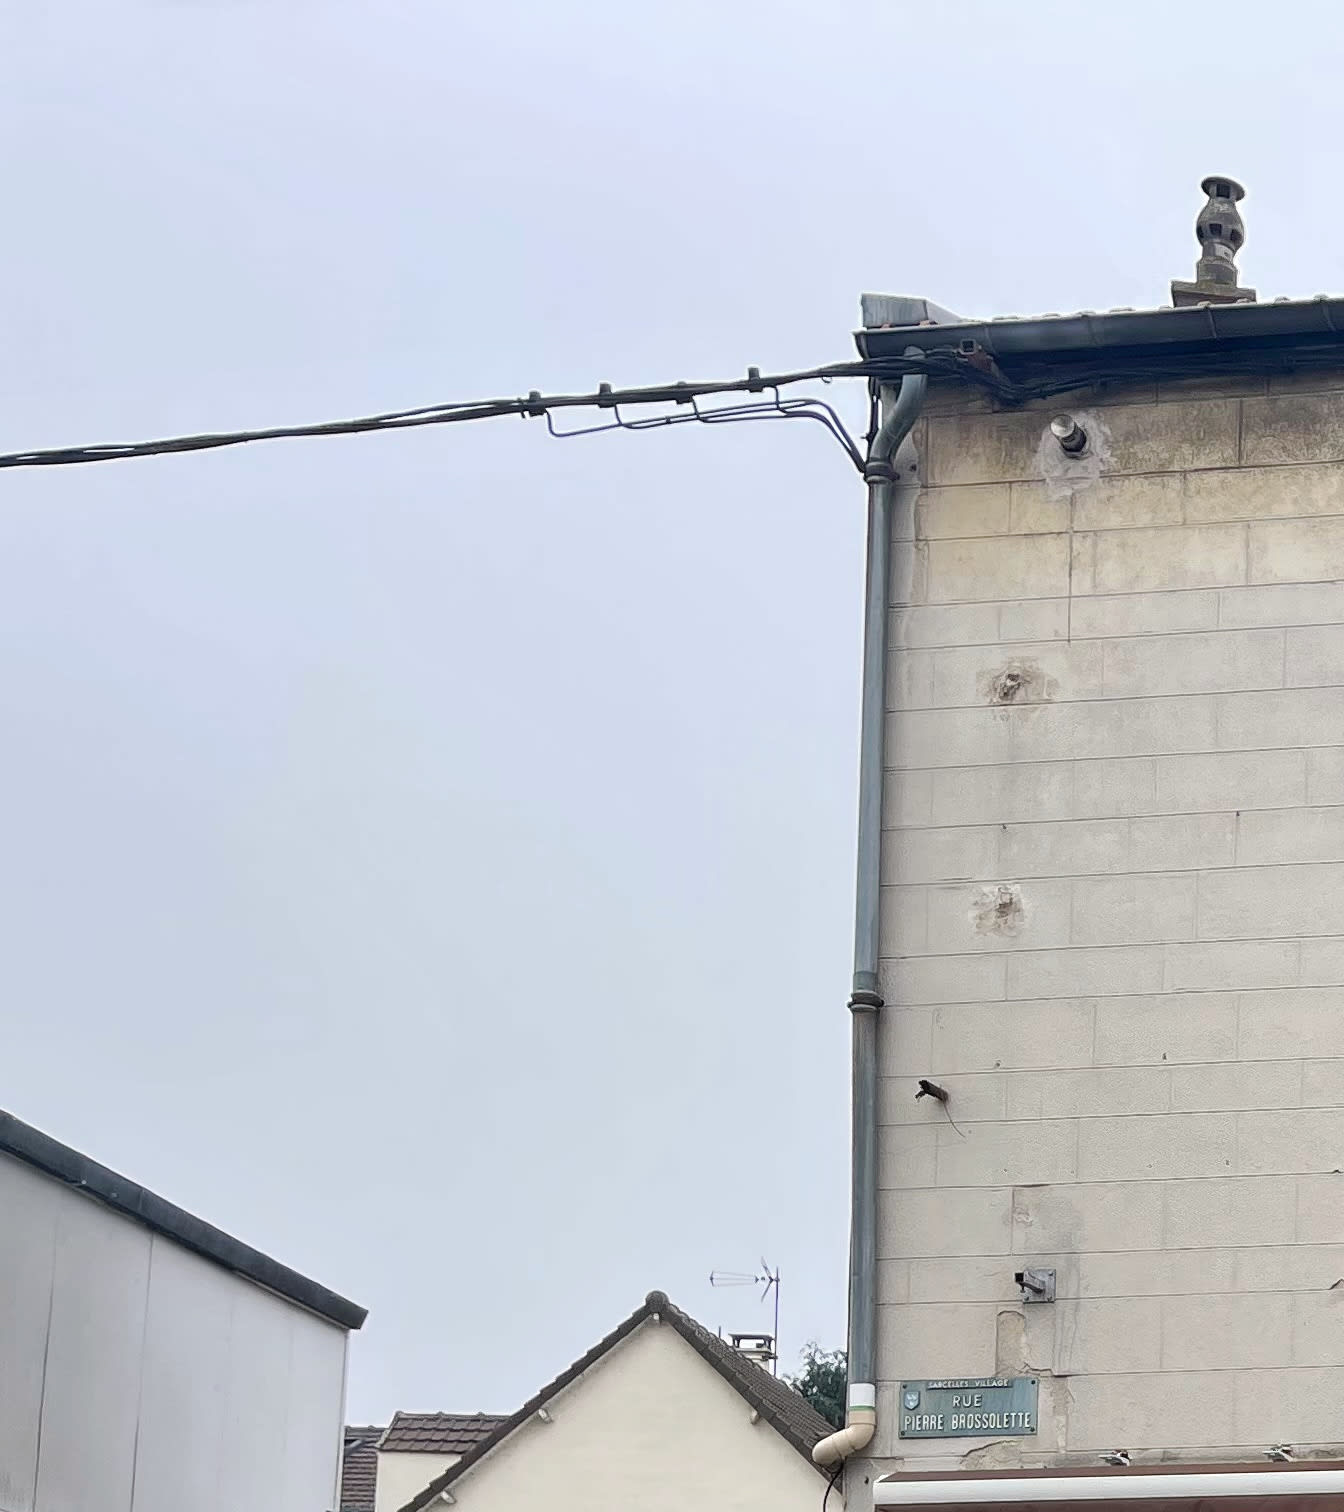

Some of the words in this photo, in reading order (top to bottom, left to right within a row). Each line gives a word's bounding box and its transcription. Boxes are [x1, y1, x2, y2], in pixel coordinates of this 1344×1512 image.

[927, 1381, 969, 1390] SARCELLES
[974, 1379, 1009, 1388] VILLAGE
[952, 1394, 983, 1408] RUE
[904, 1415, 944, 1431] PIERRE
[951, 1411, 1031, 1430] BROSSOLETTE
